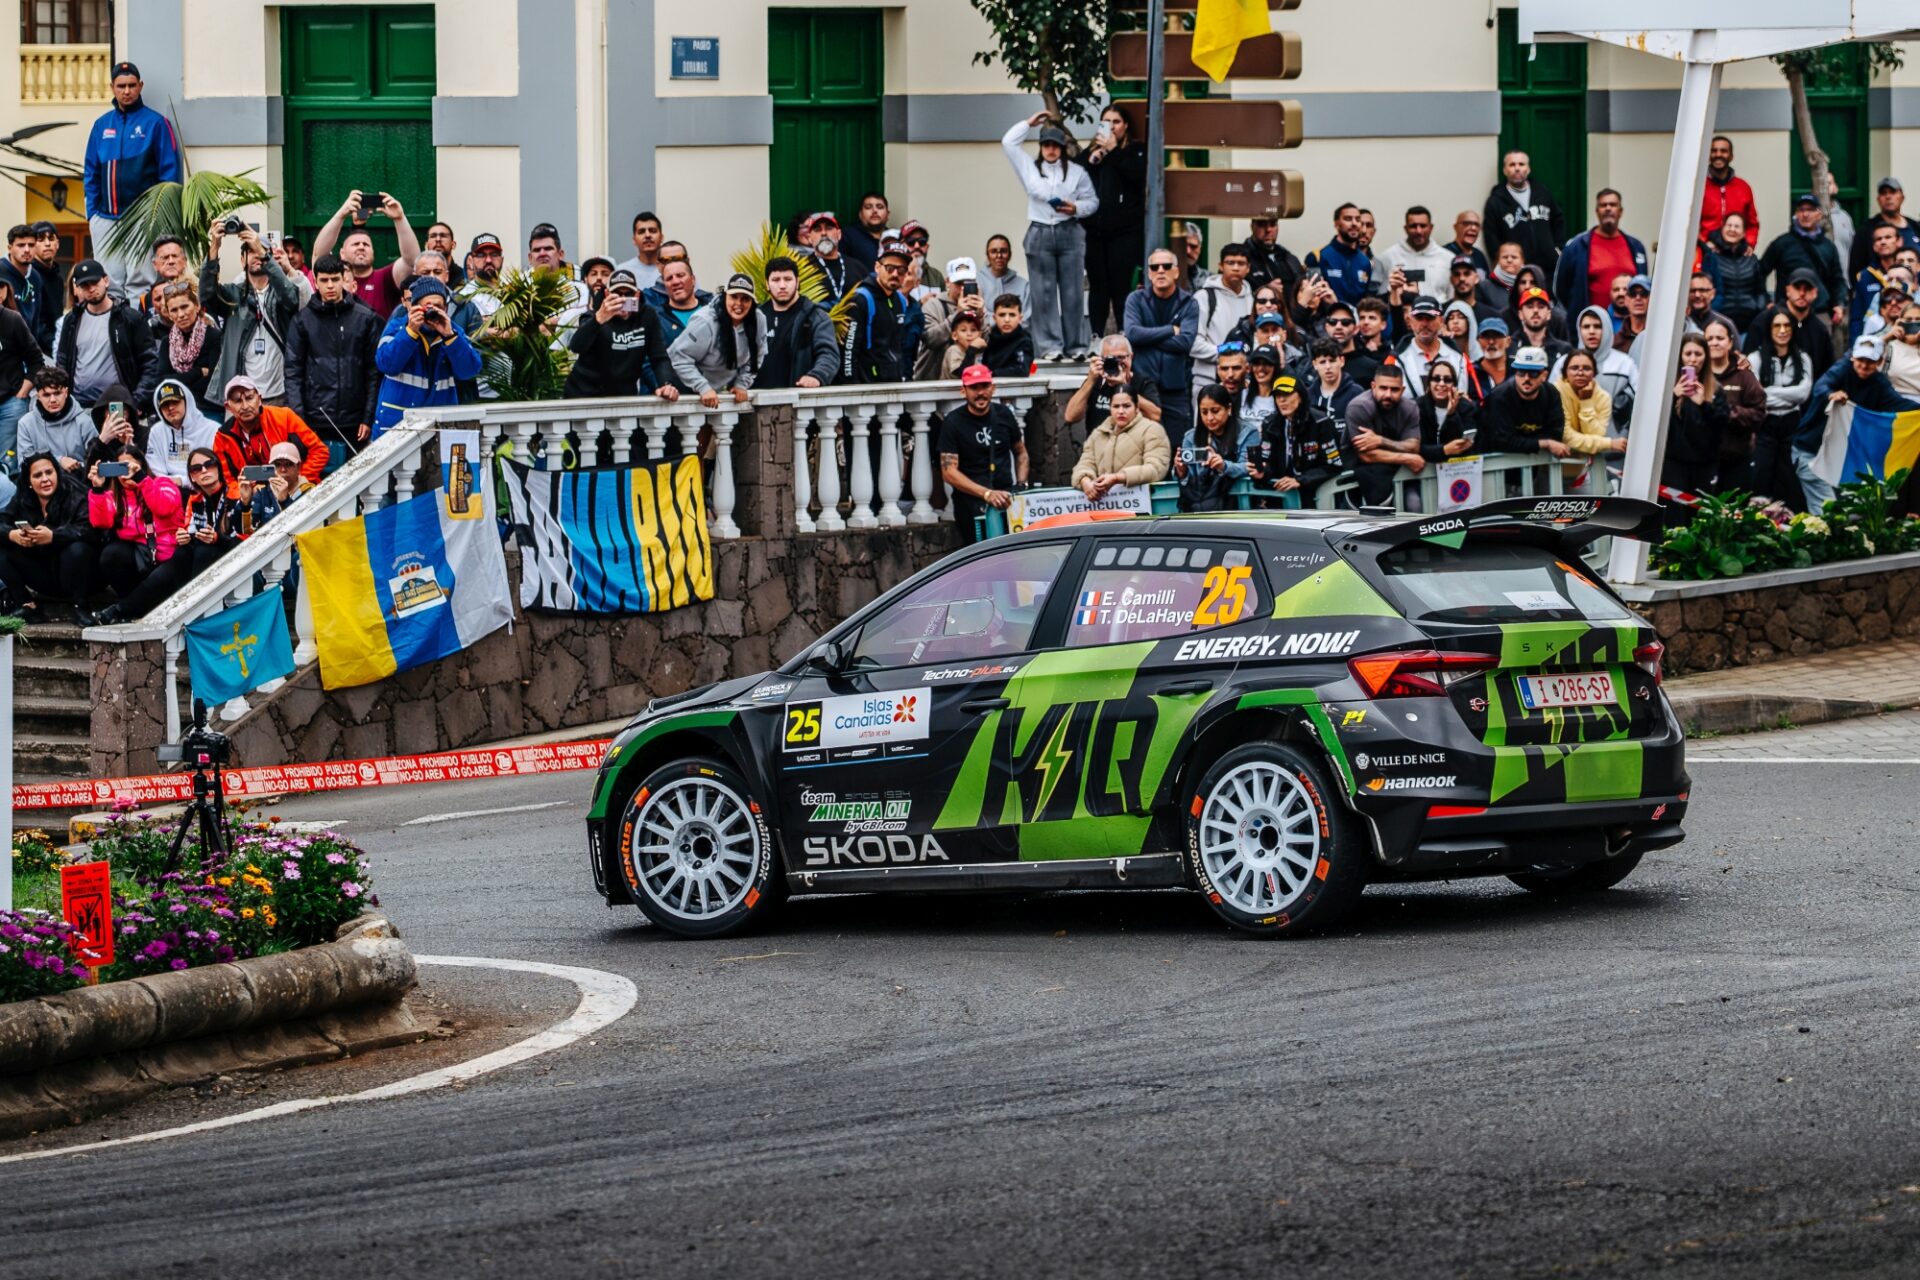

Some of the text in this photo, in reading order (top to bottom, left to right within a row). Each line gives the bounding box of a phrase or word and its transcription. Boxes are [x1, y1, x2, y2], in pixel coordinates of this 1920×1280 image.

[1029, 505, 1063, 518] SÓLO
[1534, 501, 1589, 512] EUROSOL
[1101, 590, 1175, 606] E. Camilli
[1192, 566, 1252, 626] 25
[1100, 609, 1194, 627] T. DeLaHaye
[1174, 630, 1360, 661] ENERGY. NOW!
[922, 665, 1018, 682] Techno-plus.eu
[864, 699, 892, 713] Islas
[786, 708, 821, 743] 25
[835, 712, 892, 730] Canarias
[1342, 709, 1367, 726] P1
[535, 748, 554, 759] ZONA
[556, 743, 596, 757] PROHIBIDO
[398, 758, 417, 770] ZONA
[419, 755, 459, 768] PROHIBIDO
[461, 752, 493, 765] PUBLICO
[537, 759, 561, 771] NO-GO
[562, 757, 582, 769] AREA
[587, 756, 598, 767] NO
[1372, 753, 1446, 766] VILLE DE NICE
[262, 769, 283, 781] ZONA
[284, 765, 323, 778] PROHIBIDO
[325, 763, 356, 775] PUBLICO
[400, 769, 424, 782] NO-GO
[425, 767, 445, 780] AREA
[449, 767, 460, 778] NO
[461, 765, 494, 778] GO-AREA
[23, 783, 60, 794] PROHIBIDO
[62, 782, 93, 793] PUBLICO
[131, 778, 150, 789] ZONA
[152, 775, 190, 787] PROHIBIDO
[266, 780, 289, 792] NO-GO
[290, 778, 309, 790] AREA
[313, 778, 324, 788] NO
[326, 776, 358, 788] GO-AREA
[28, 795, 47, 806] AREA
[50, 794, 61, 804] NO
[62, 792, 94, 804] GO-AREA
[134, 788, 157, 800] NO-GO
[158, 786, 177, 798] AREA
[181, 785, 192, 797] NO
[801, 790, 836, 805] team
[808, 800, 912, 822] MINERVA OIL
